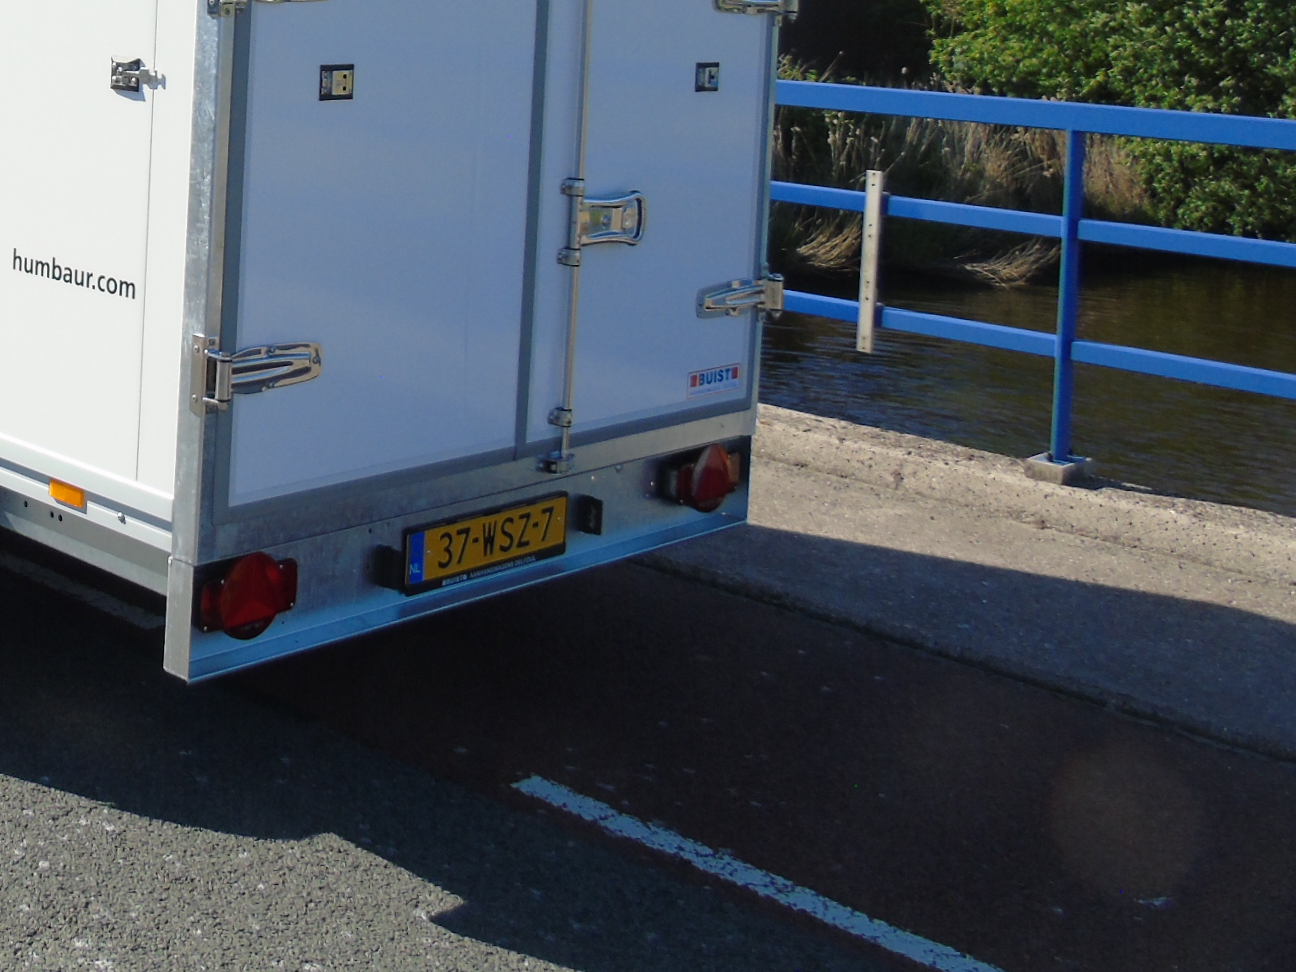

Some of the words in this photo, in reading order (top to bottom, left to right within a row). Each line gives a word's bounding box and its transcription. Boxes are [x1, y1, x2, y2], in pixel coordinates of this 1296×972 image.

[12, 248, 136, 300] humbaur.com
[698, 368, 731, 386] BUIST
[409, 562, 421, 574] NL
[437, 506, 555, 569] 37-WSZ-7
